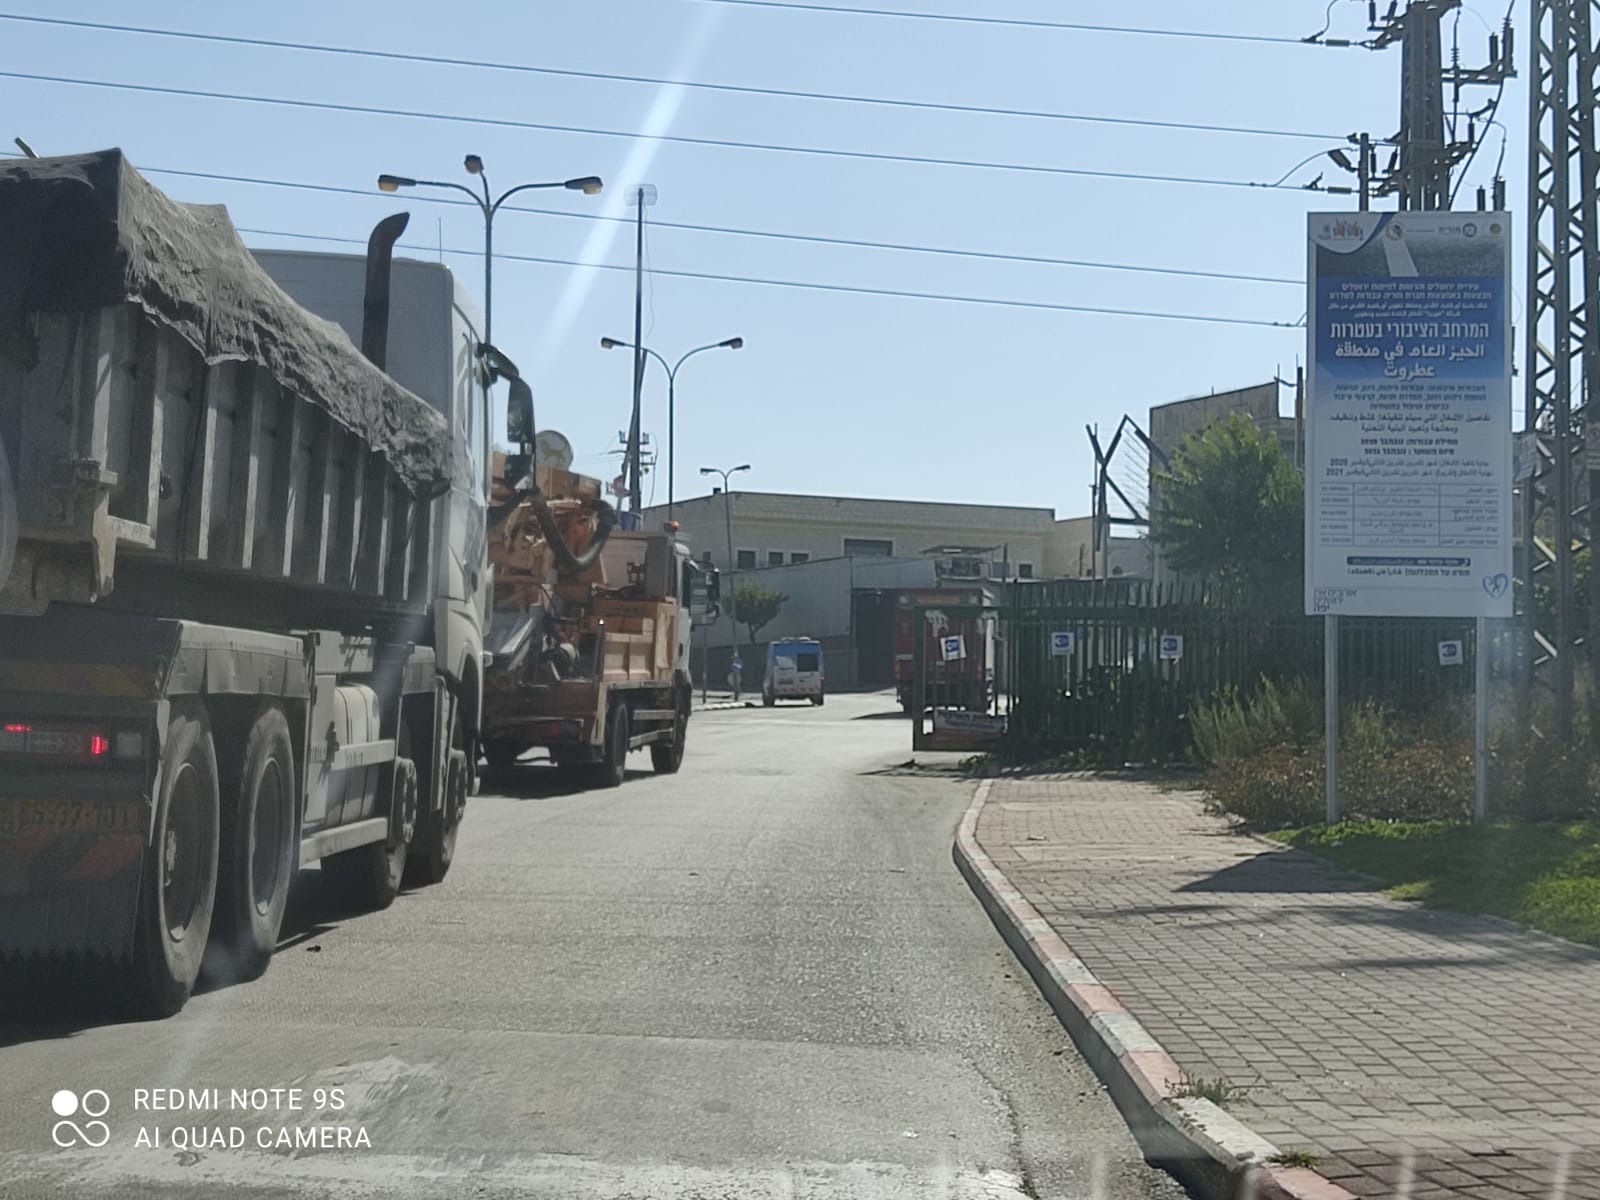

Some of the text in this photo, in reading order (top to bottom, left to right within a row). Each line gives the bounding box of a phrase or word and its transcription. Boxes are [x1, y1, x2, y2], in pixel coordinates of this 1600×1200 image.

[1330, 322, 1489, 338] המרחב הציבורי בעטרות
[1335, 341, 1485, 362] الحيز العام في منطقة
[1384, 360, 1435, 380] عطروت
